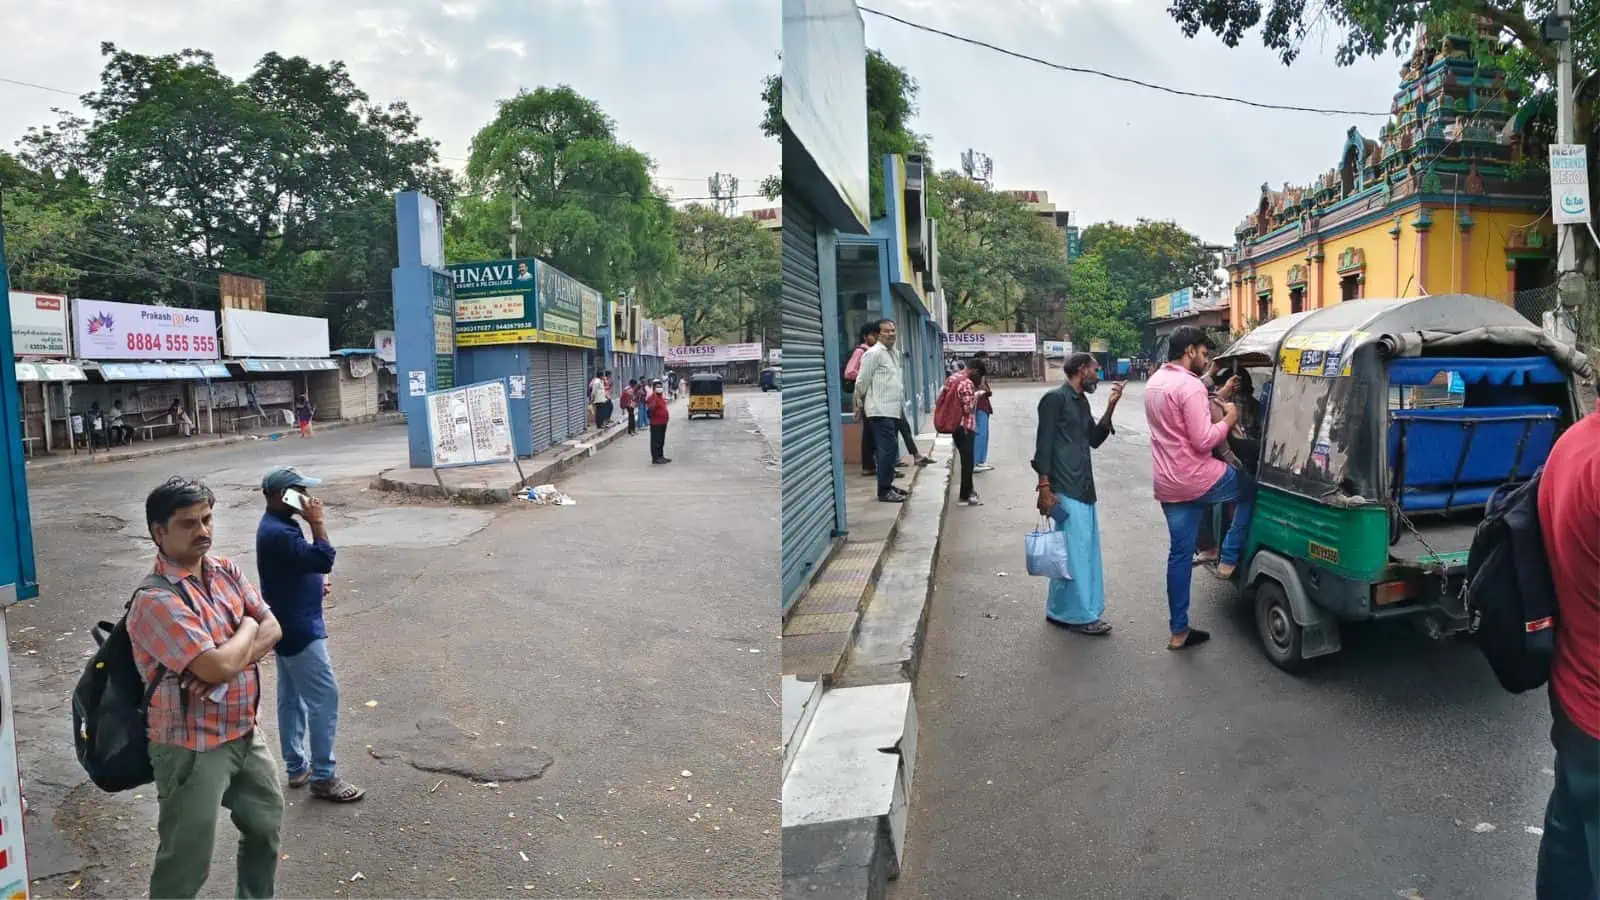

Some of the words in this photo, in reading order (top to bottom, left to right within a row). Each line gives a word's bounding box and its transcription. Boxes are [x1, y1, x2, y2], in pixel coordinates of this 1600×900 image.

[140, 310, 172, 321] Prakash
[184, 314, 199, 323] Arts
[127, 333, 161, 351] 8884
[166, 334, 189, 352] 555
[193, 336, 215, 353] 555
[676, 346, 715, 355] GENESIS
